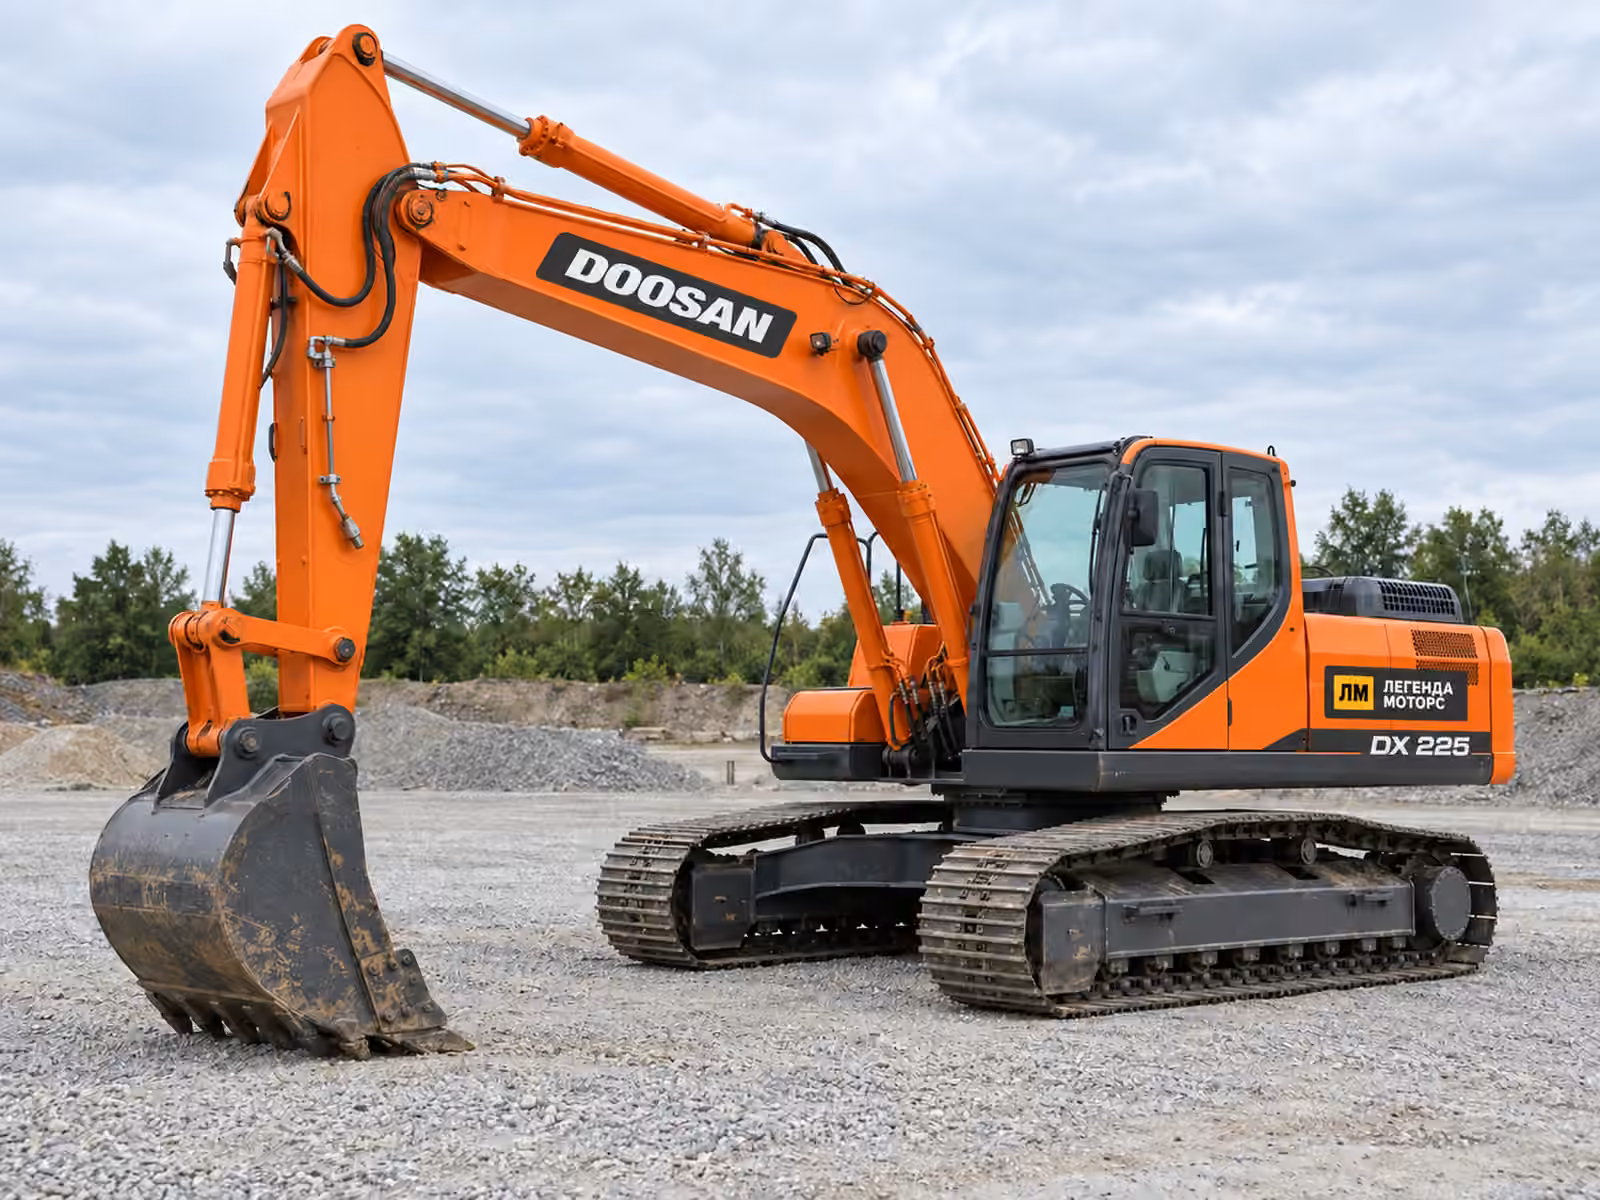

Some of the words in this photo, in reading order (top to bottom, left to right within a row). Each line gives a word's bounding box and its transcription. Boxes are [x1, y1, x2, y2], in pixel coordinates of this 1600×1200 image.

[564, 248, 774, 344] DOOSAN
[1338, 683, 1369, 702] ЛМ
[1383, 680, 1453, 697] ЛЕГЕНДА
[1383, 695, 1446, 710] МОТОРС
[1370, 735, 1410, 756] DX
[1415, 736, 1470, 756] 225
